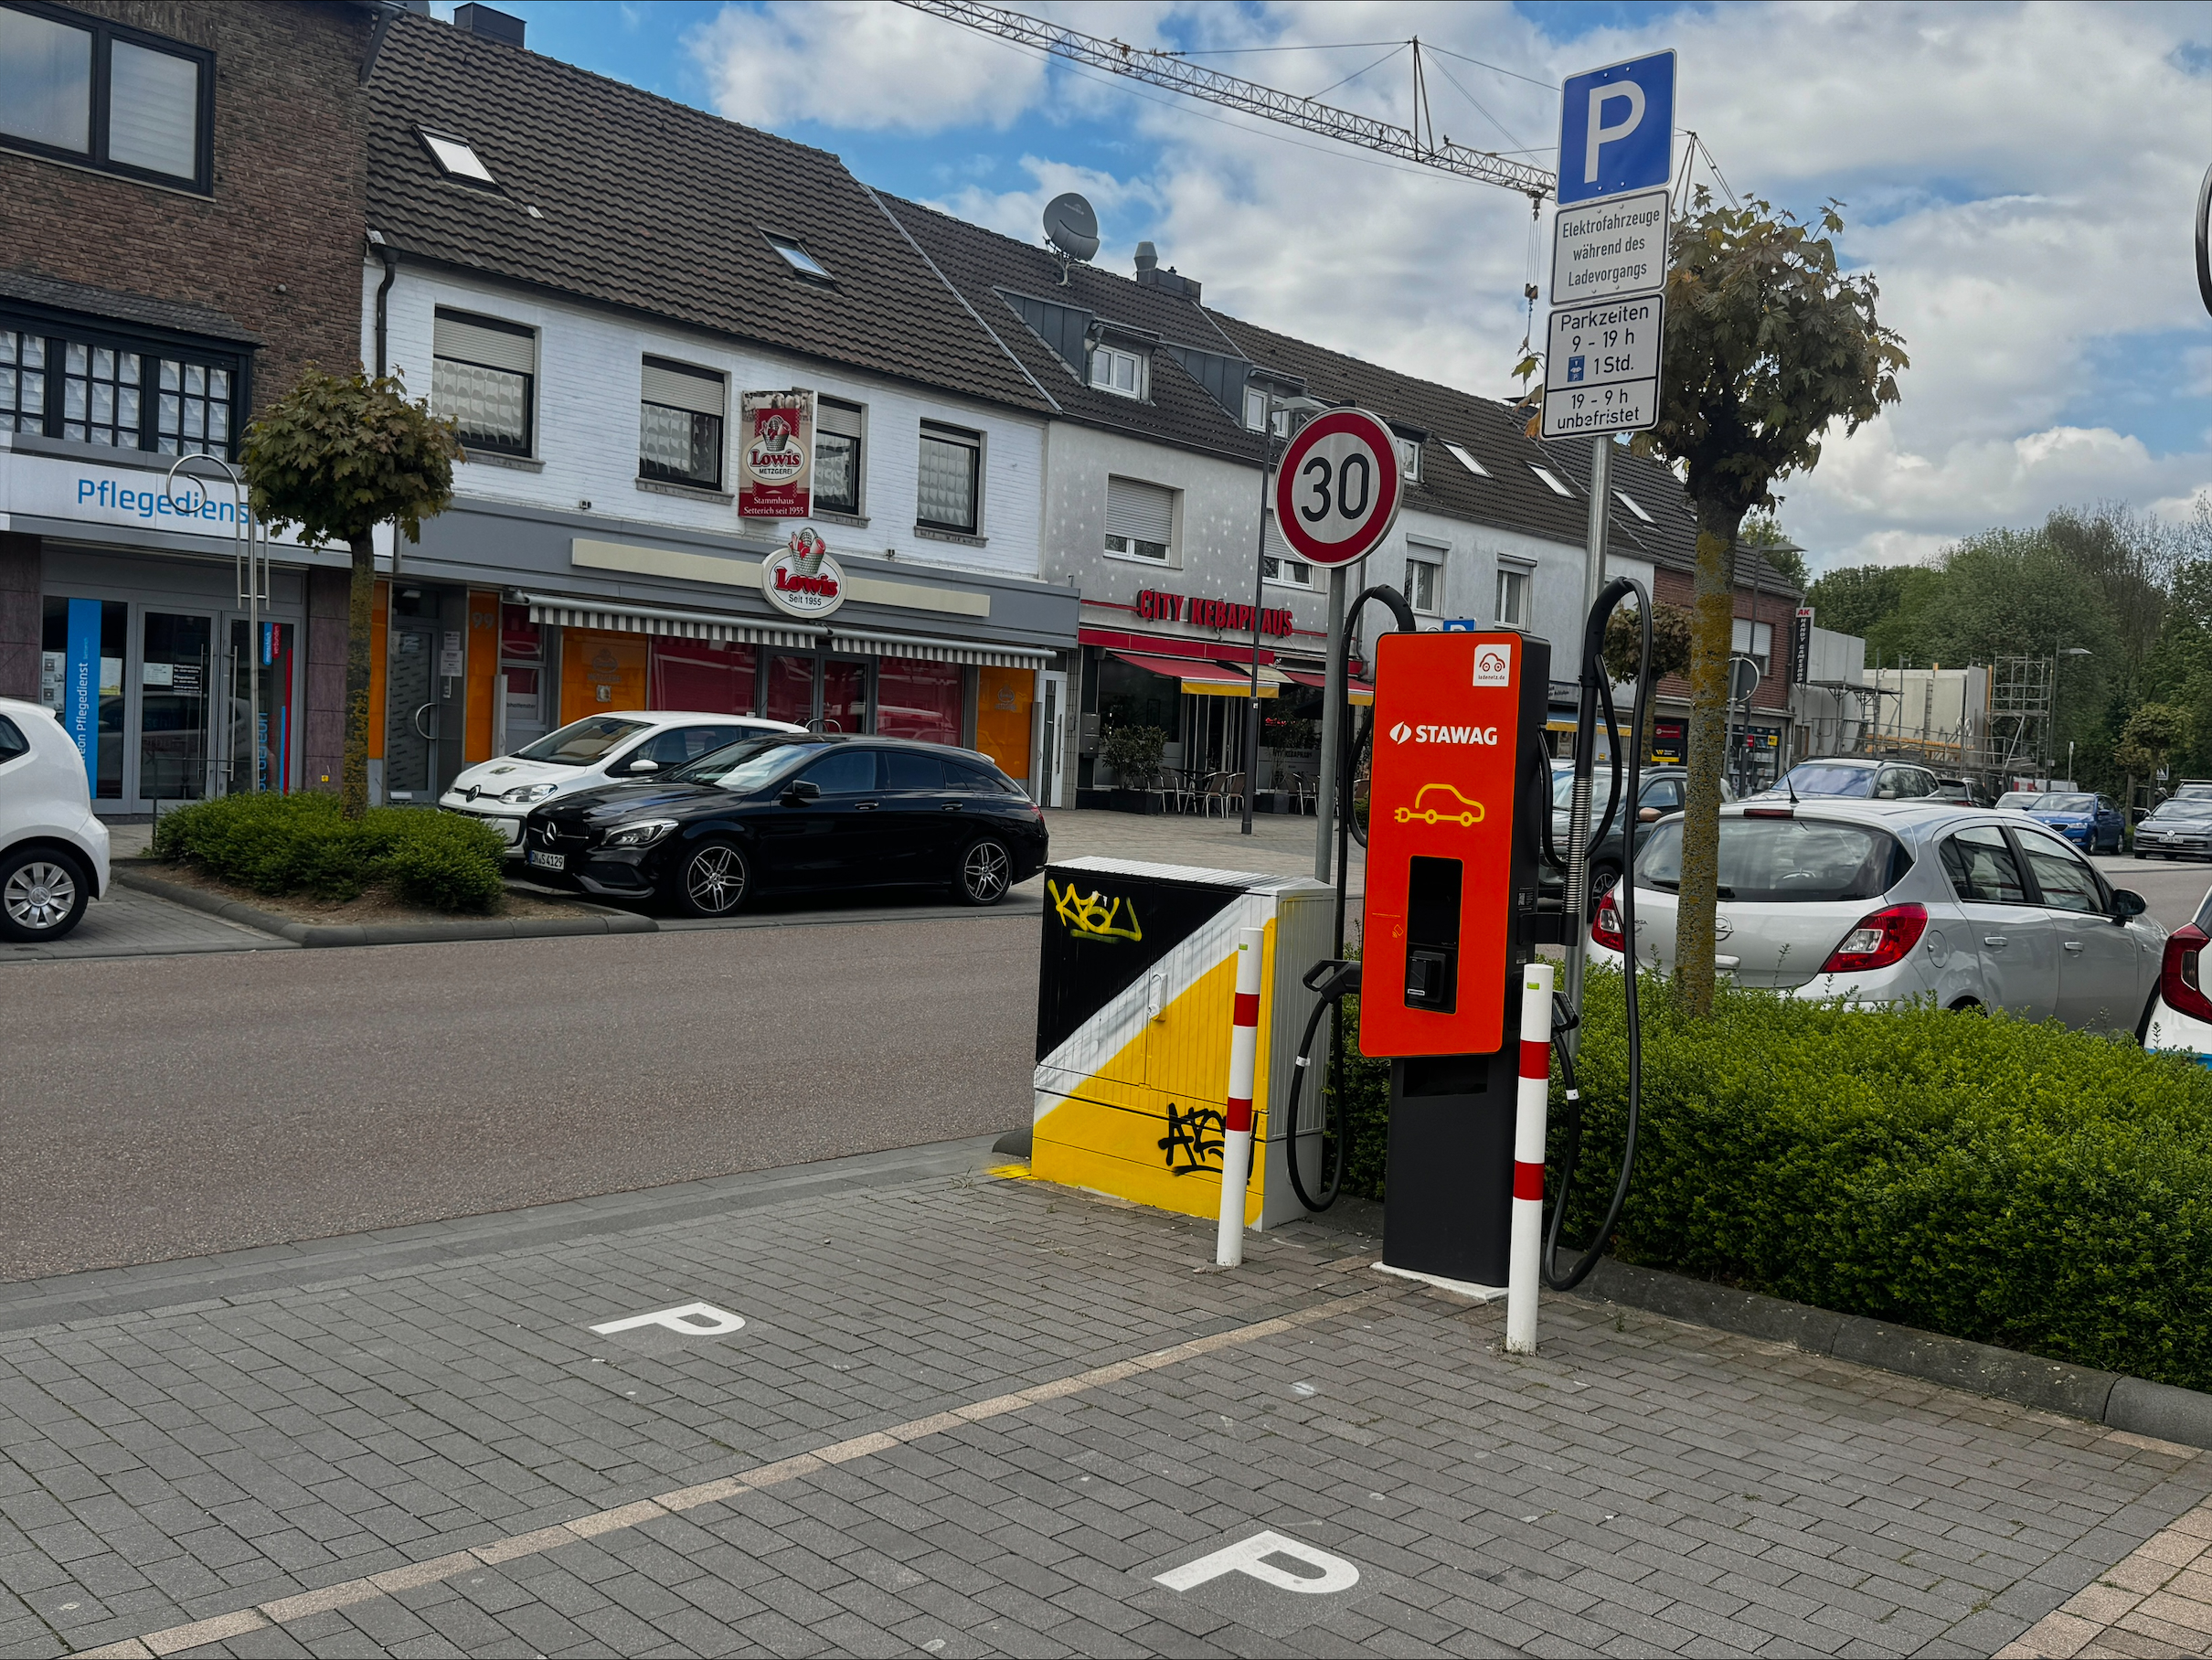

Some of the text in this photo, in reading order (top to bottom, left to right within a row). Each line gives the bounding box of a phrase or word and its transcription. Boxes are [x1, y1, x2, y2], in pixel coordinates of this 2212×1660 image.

[1584, 80, 1646, 184] P
[1563, 210, 1660, 238] Elektrofahrzeuge
[1573, 236, 1645, 261] während des
[1569, 263, 1647, 286] Ladevorgangs
[1561, 306, 1649, 331] Parkzeiten
[1572, 335, 1581, 353] 9
[1602, 330, 1618, 348] 19
[1625, 328, 1634, 345] h
[1594, 354, 1634, 375] 1 Std.
[1571, 393, 1585, 410] 19
[1605, 390, 1613, 406] 9
[1620, 388, 1628, 403] h
[1558, 407, 1640, 430] unbefristet
[750, 448, 802, 467] Lowis
[1301, 452, 1370, 522] 30
[78, 479, 261, 526] Pflegediens
[743, 506, 804, 515] Setterich seit 1955
[753, 496, 794, 505] Stammhaus
[774, 566, 838, 598] Lowis
[789, 594, 822, 606] Seit 1955
[1139, 590, 1185, 622] CITY
[76, 662, 89, 730] Pflegedienst
[1415, 725, 1498, 746] STAWAG
[590, 1302, 746, 1335] P
[1152, 1529, 1360, 1594] P
